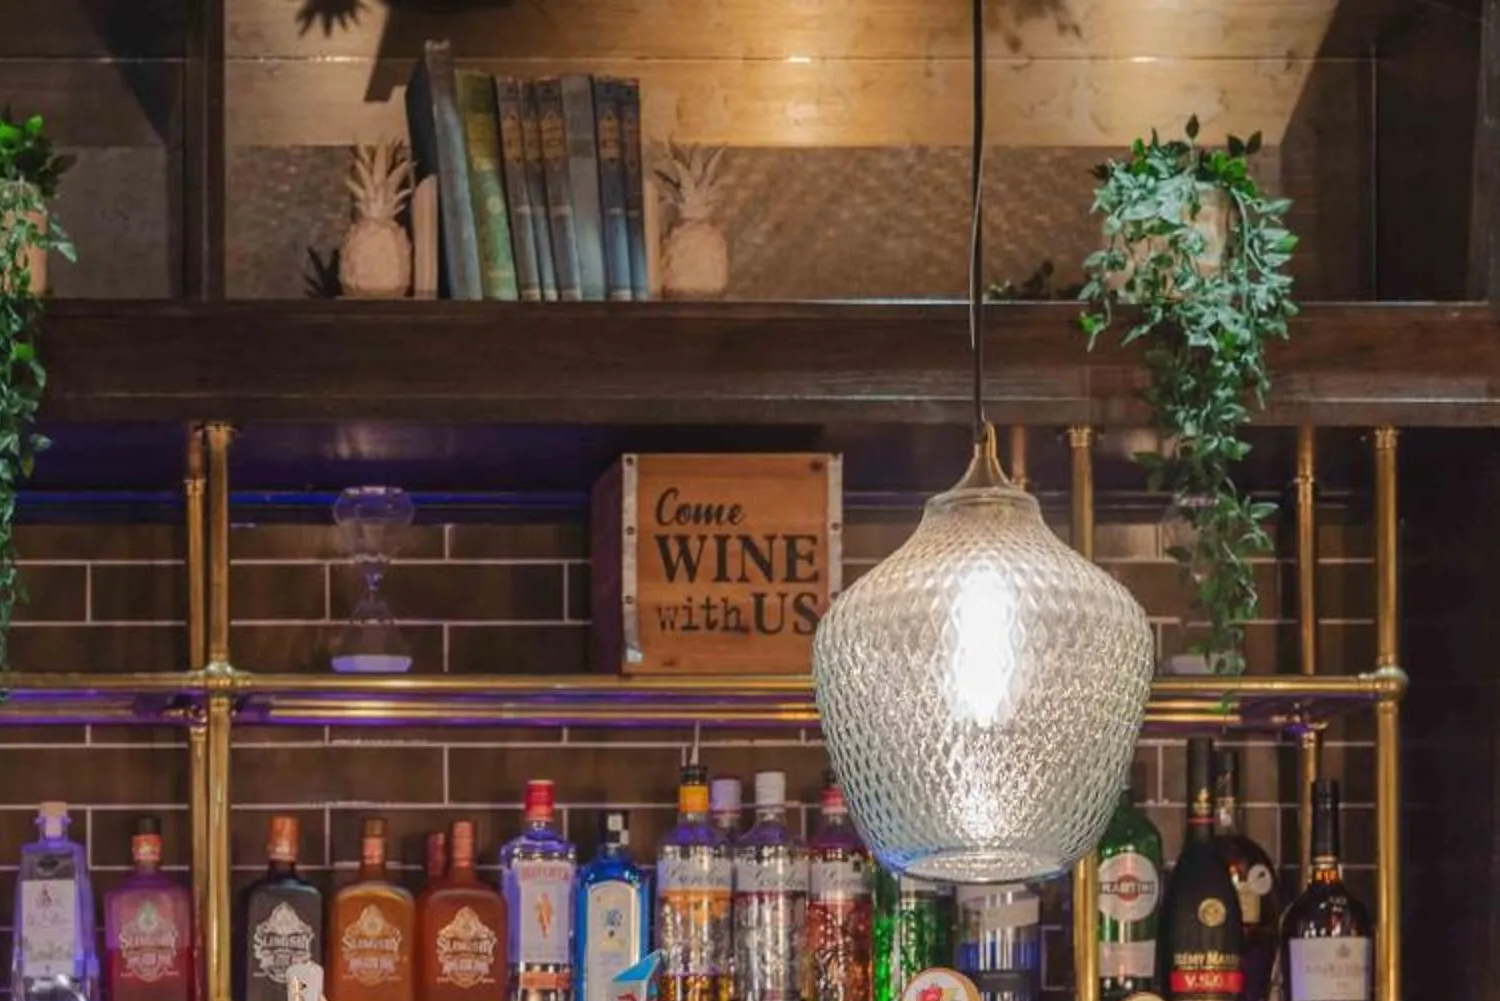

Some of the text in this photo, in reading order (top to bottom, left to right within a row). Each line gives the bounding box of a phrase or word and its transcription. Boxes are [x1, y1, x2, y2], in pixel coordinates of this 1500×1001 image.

[655, 486, 746, 527] Come
[654, 533, 820, 584] WINE
[656, 591, 820, 636] with US
